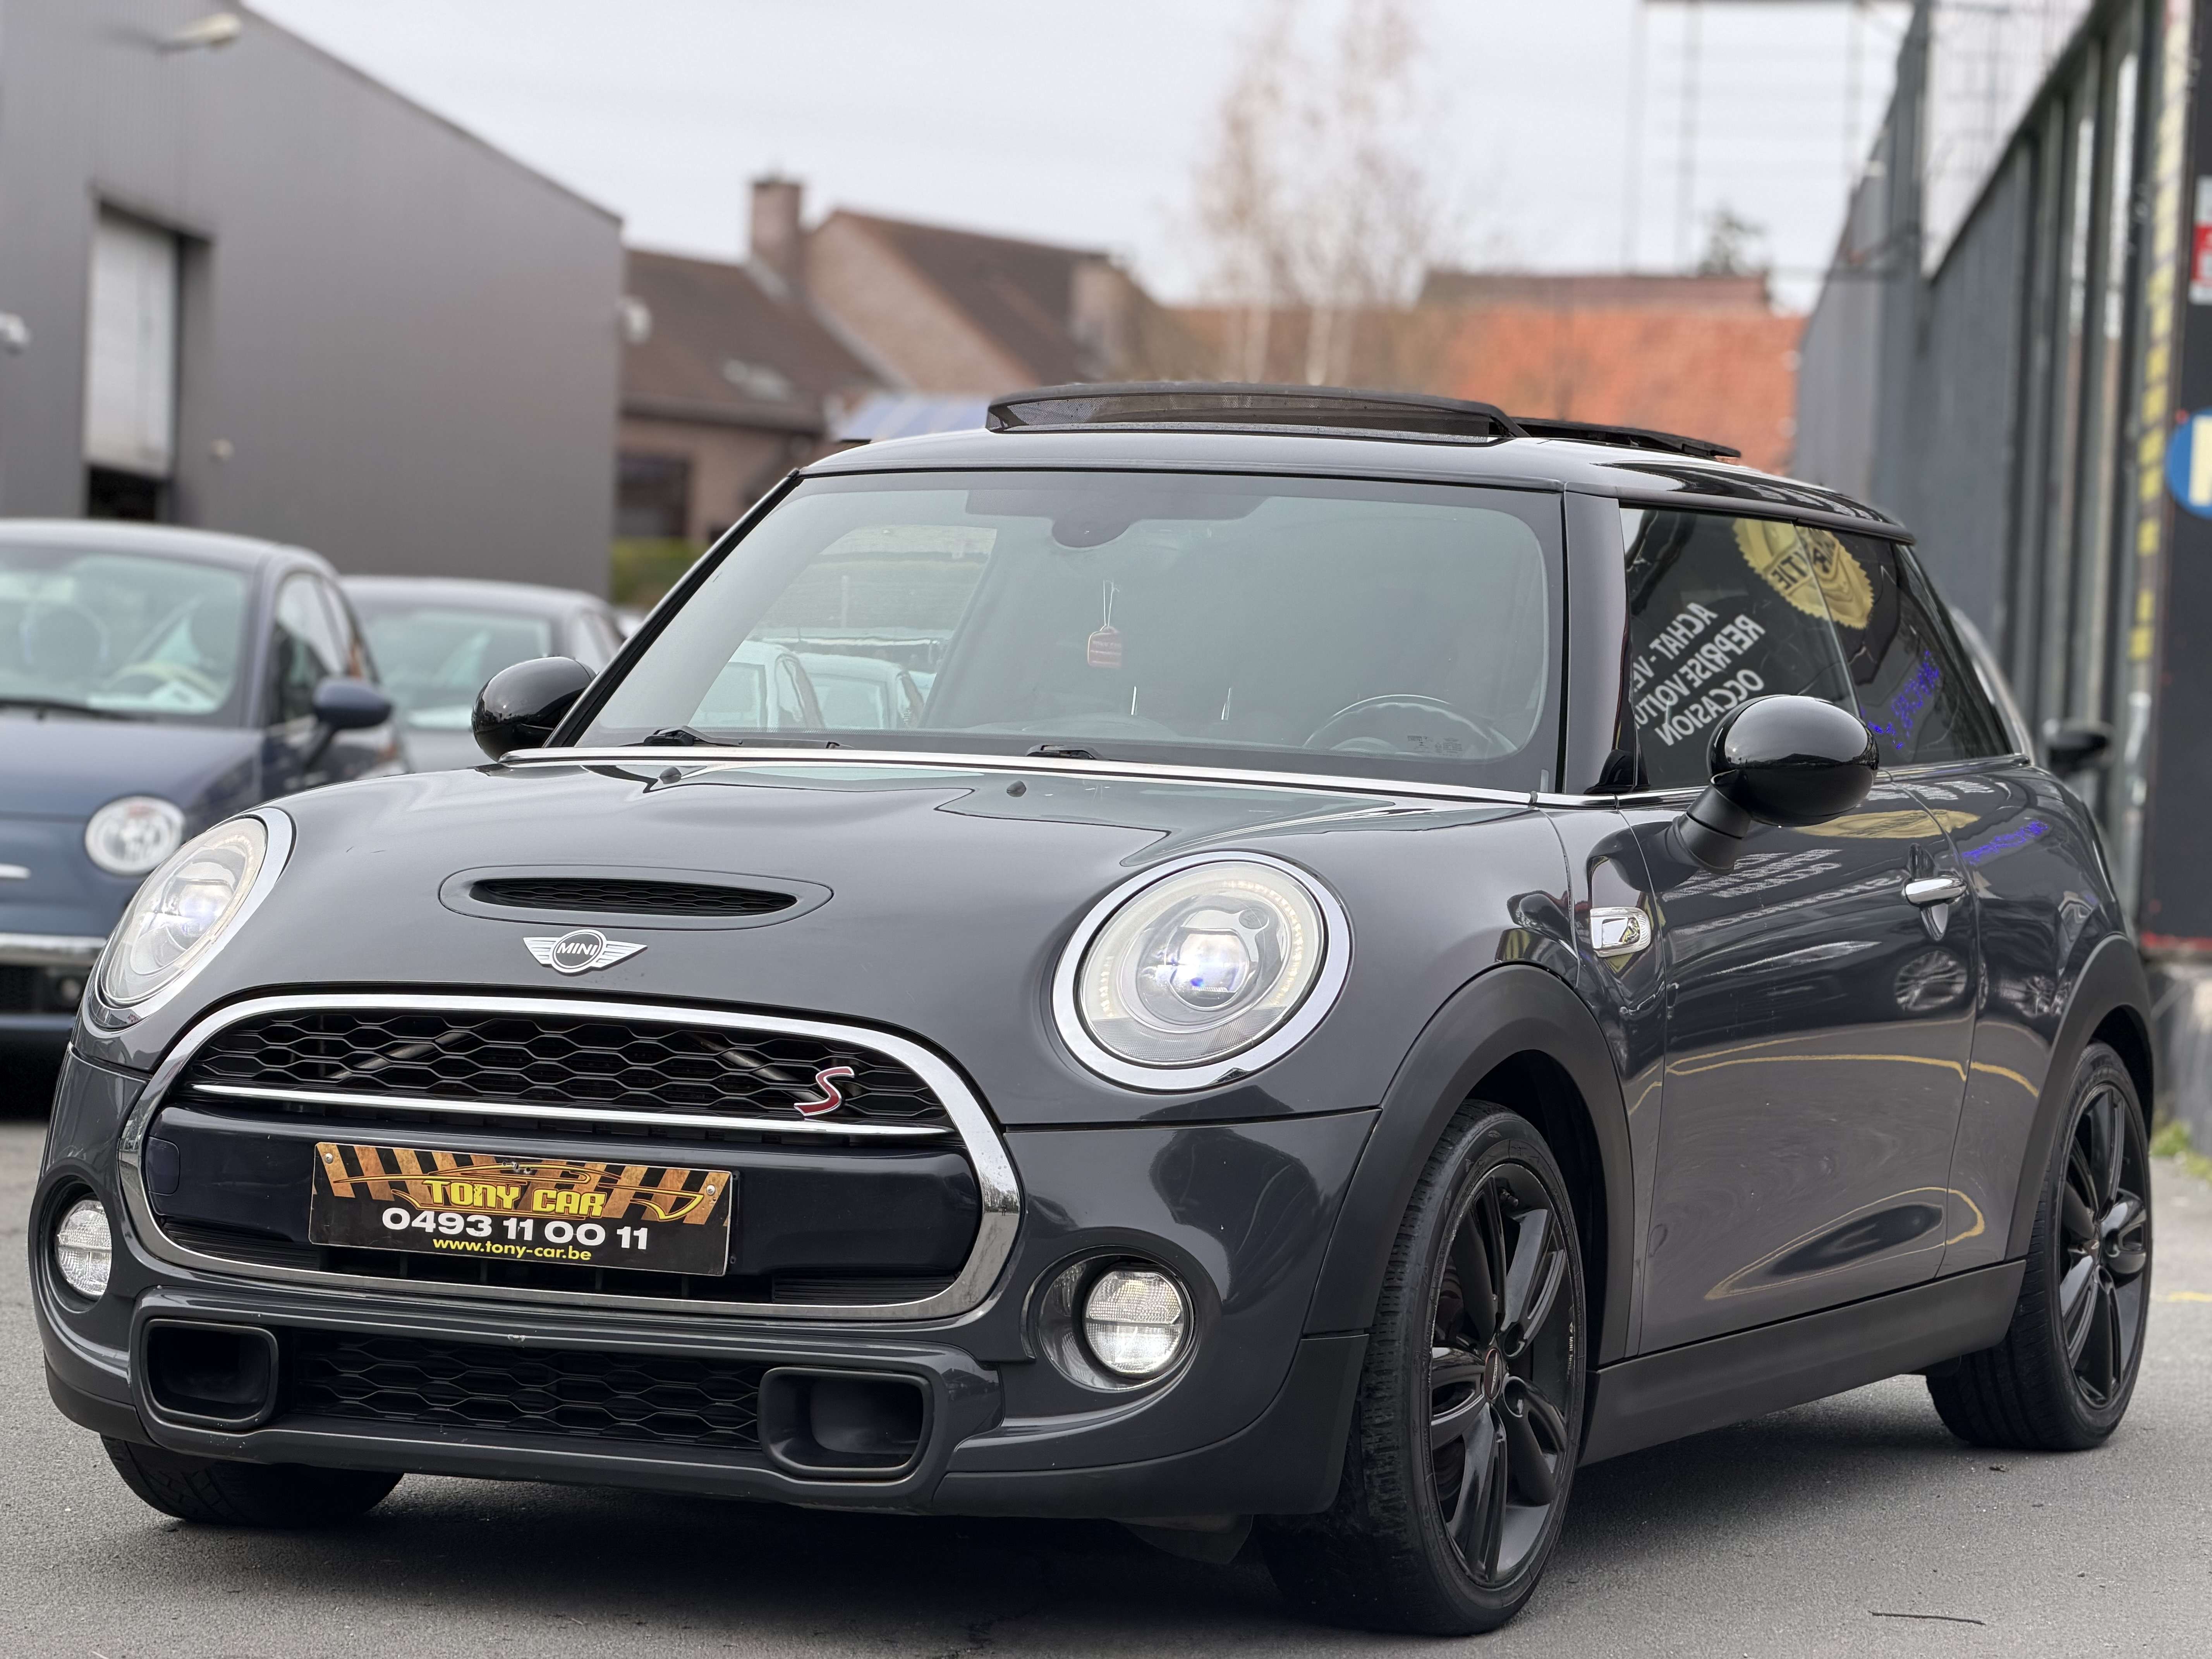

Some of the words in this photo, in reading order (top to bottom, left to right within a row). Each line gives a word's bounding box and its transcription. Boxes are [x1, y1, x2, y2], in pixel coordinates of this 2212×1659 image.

[556, 942, 598, 955] MINI
[793, 1066, 855, 1116] S
[422, 1180, 520, 1210] TONY
[532, 1189, 606, 1217] CAR
[382, 1207, 492, 1237] 0493
[503, 1217, 534, 1241] 11
[544, 1221, 606, 1246] 00
[617, 1226, 648, 1250] 11
[433, 1238, 592, 1261] www.tony-car.be
